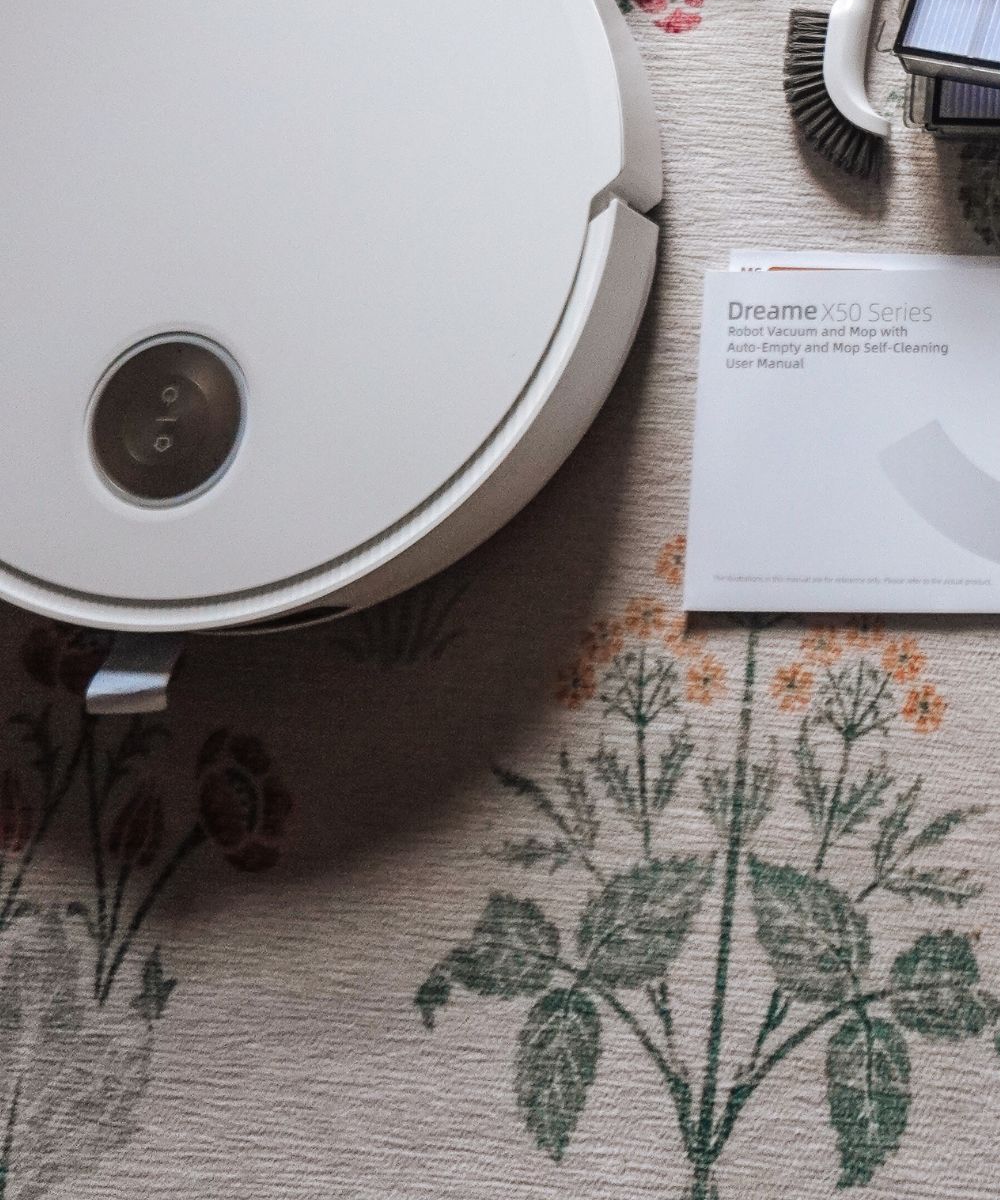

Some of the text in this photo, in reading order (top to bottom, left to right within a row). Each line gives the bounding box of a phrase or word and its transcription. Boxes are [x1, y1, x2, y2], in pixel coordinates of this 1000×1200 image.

[728, 301, 932, 322] Dreame X50 Series
[728, 326, 908, 341] Robot Vacuum and Mop with
[727, 341, 949, 356] Auto-Empty and Mop Self-Cleaning
[726, 358, 805, 369] User Manual
